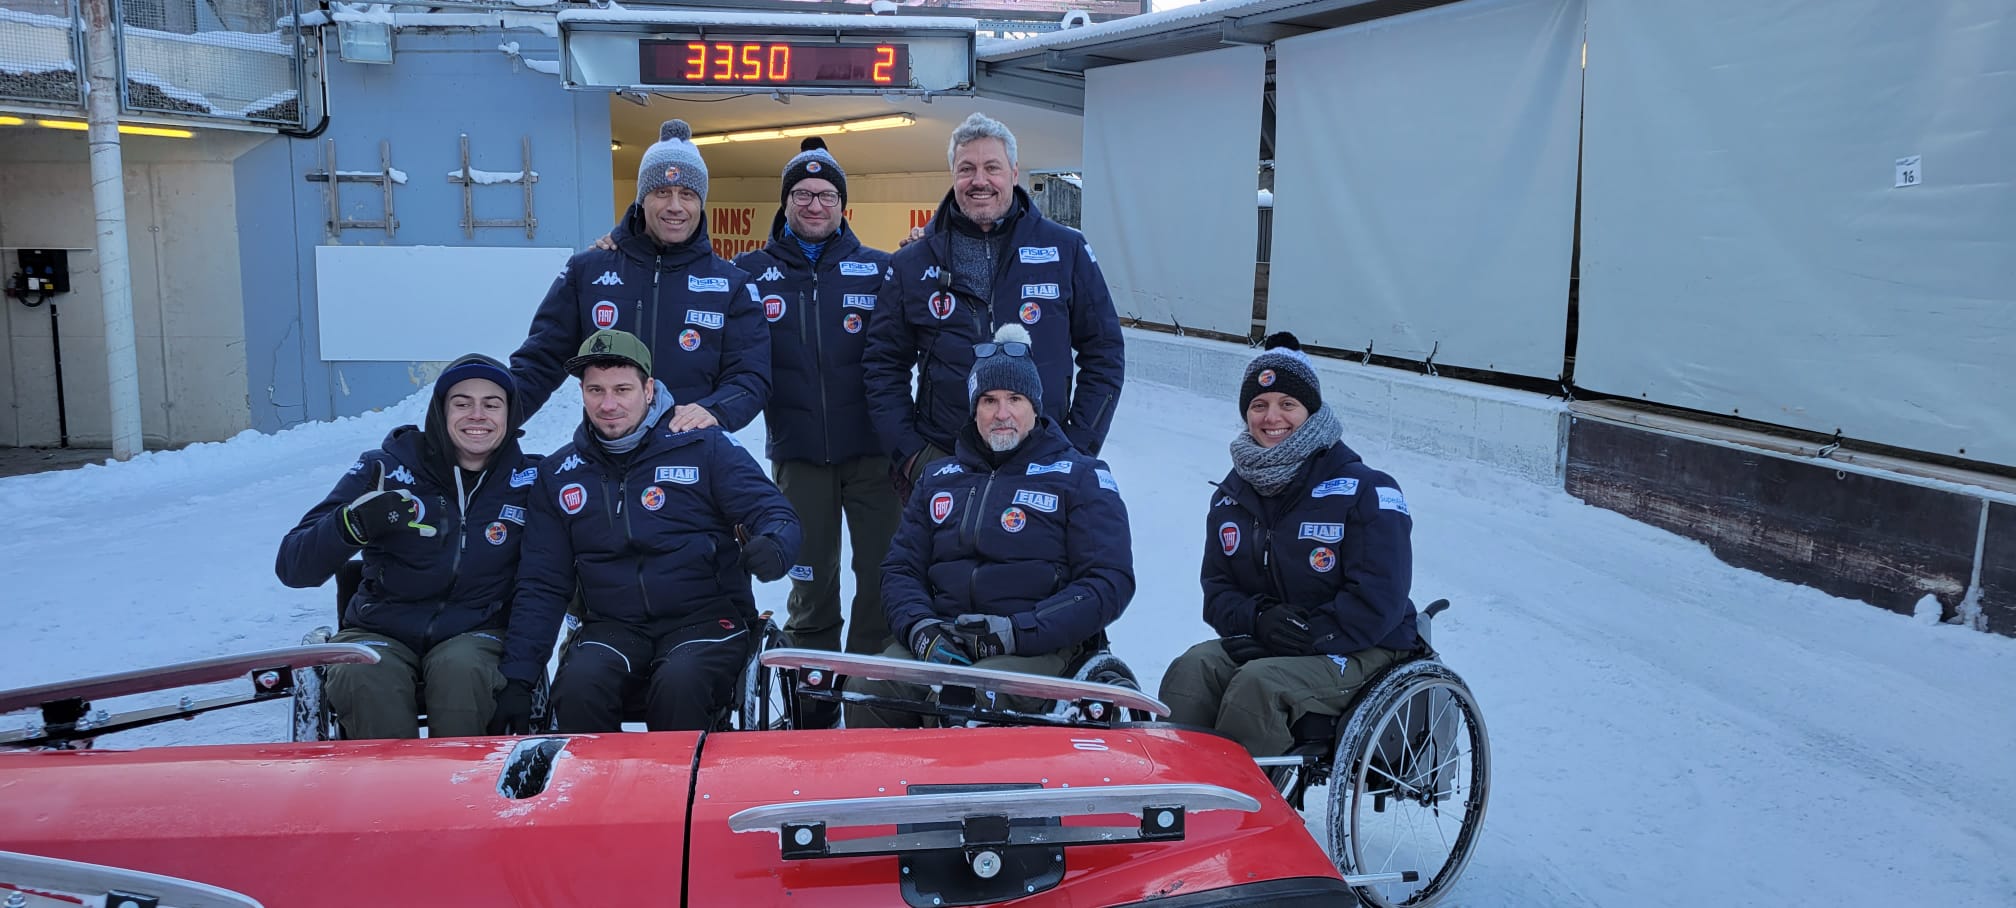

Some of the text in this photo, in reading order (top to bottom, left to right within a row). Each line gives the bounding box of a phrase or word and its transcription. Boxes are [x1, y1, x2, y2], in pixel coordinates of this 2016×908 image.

[685, 44, 894, 81] 33.50 2
[1902, 170, 1914, 184] 16
[712, 208, 755, 235] INNS'
[598, 310, 613, 323] FIAT
[765, 303, 780, 316] FIAT
[564, 491, 580, 507] FIAT
[504, 506, 524, 520] ELA
[936, 501, 950, 516] FIAT
